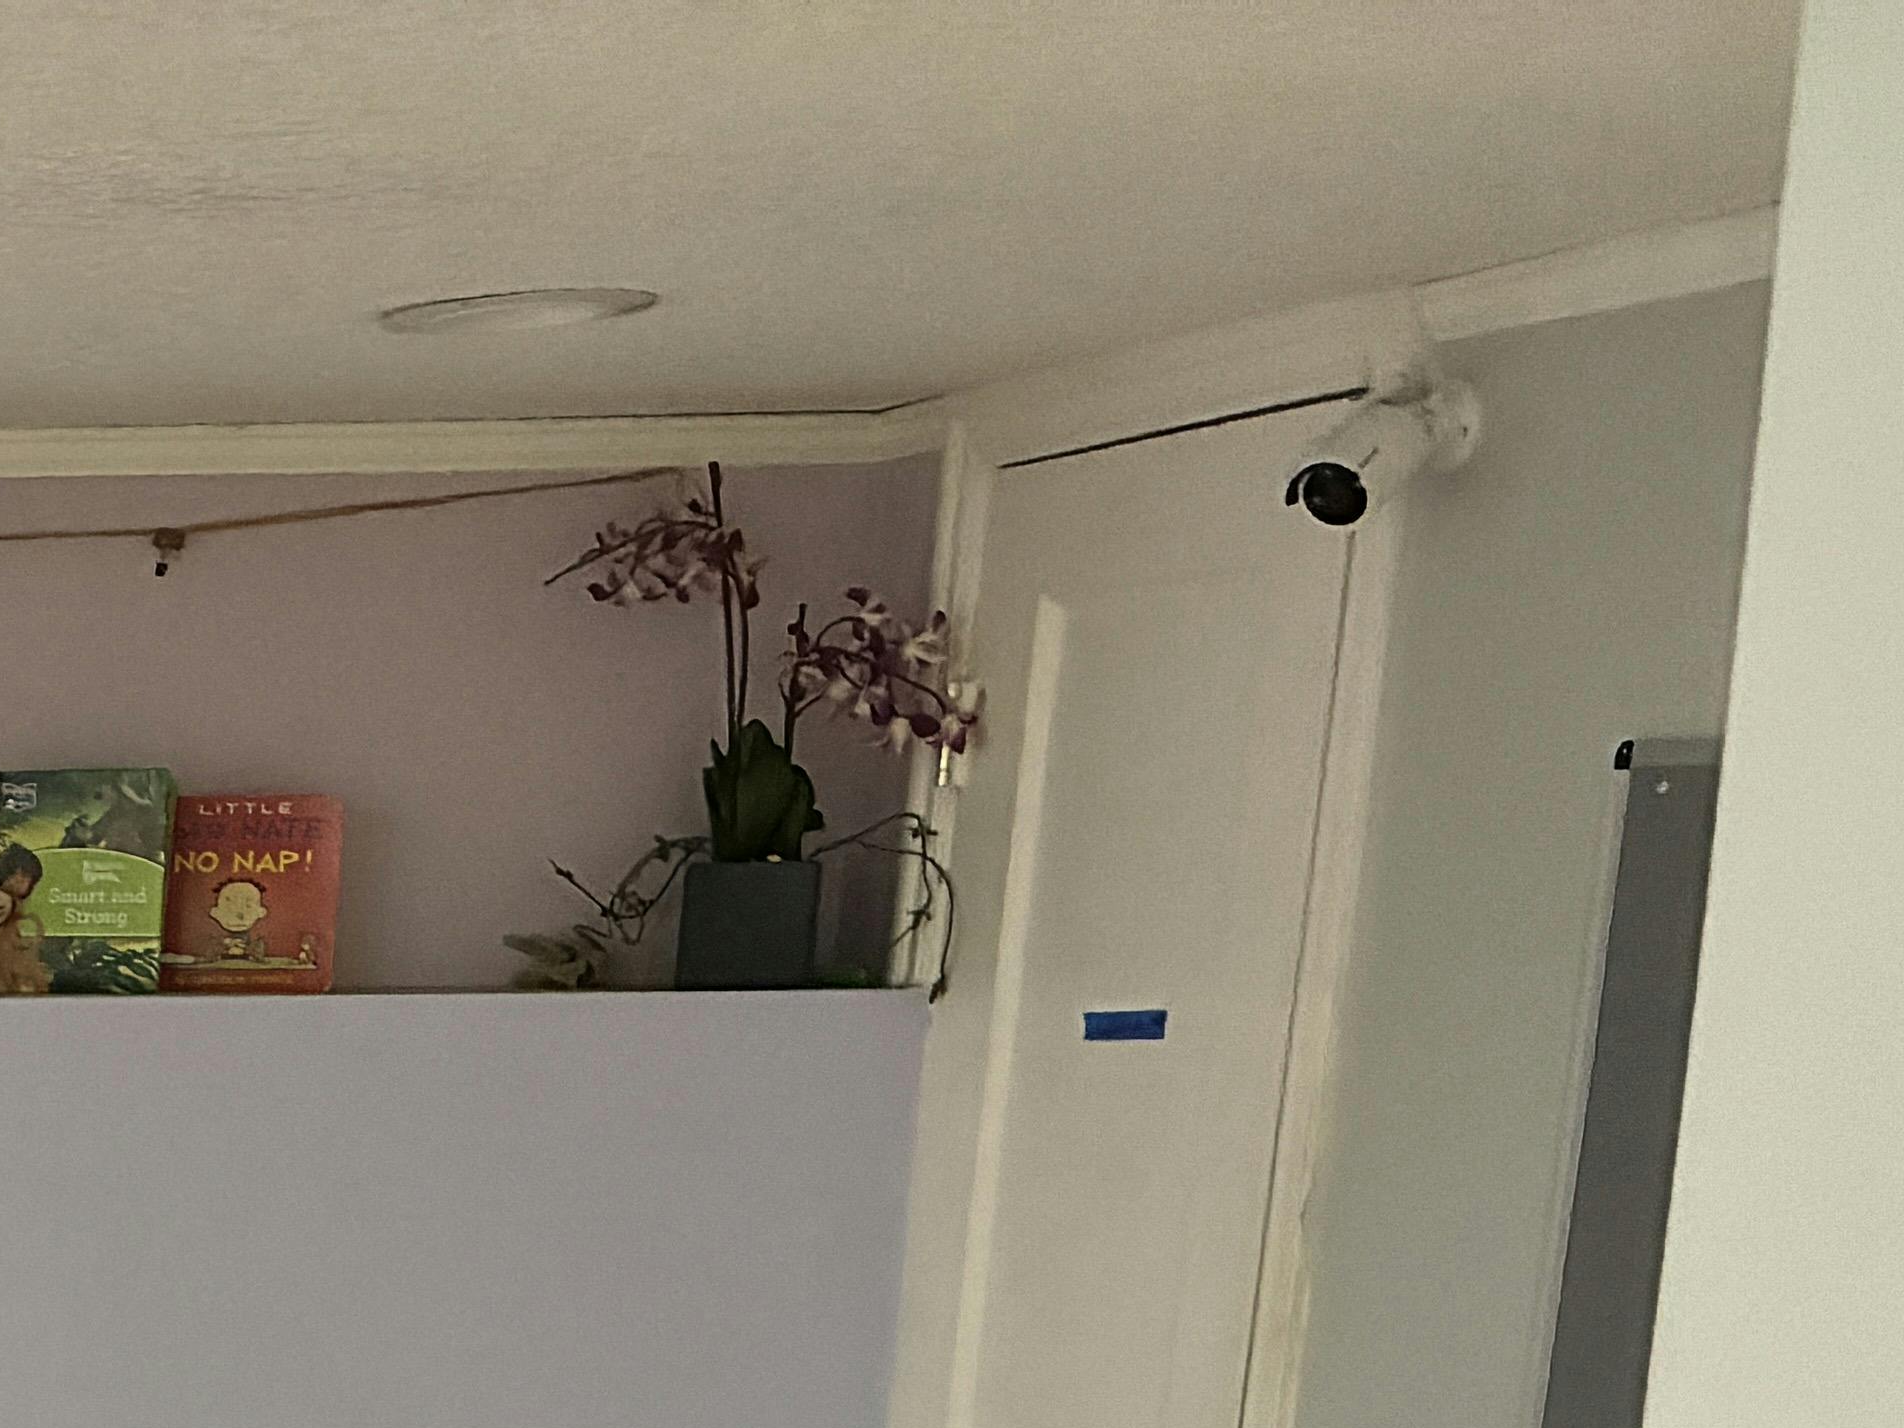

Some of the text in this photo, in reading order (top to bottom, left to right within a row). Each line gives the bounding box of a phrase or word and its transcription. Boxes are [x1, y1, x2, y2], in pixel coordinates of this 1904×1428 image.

[199, 802, 294, 816] LITTLE
[174, 849, 314, 873] NO NAP!
[49, 886, 147, 904] Smart and
[64, 908, 128, 928] Strong
